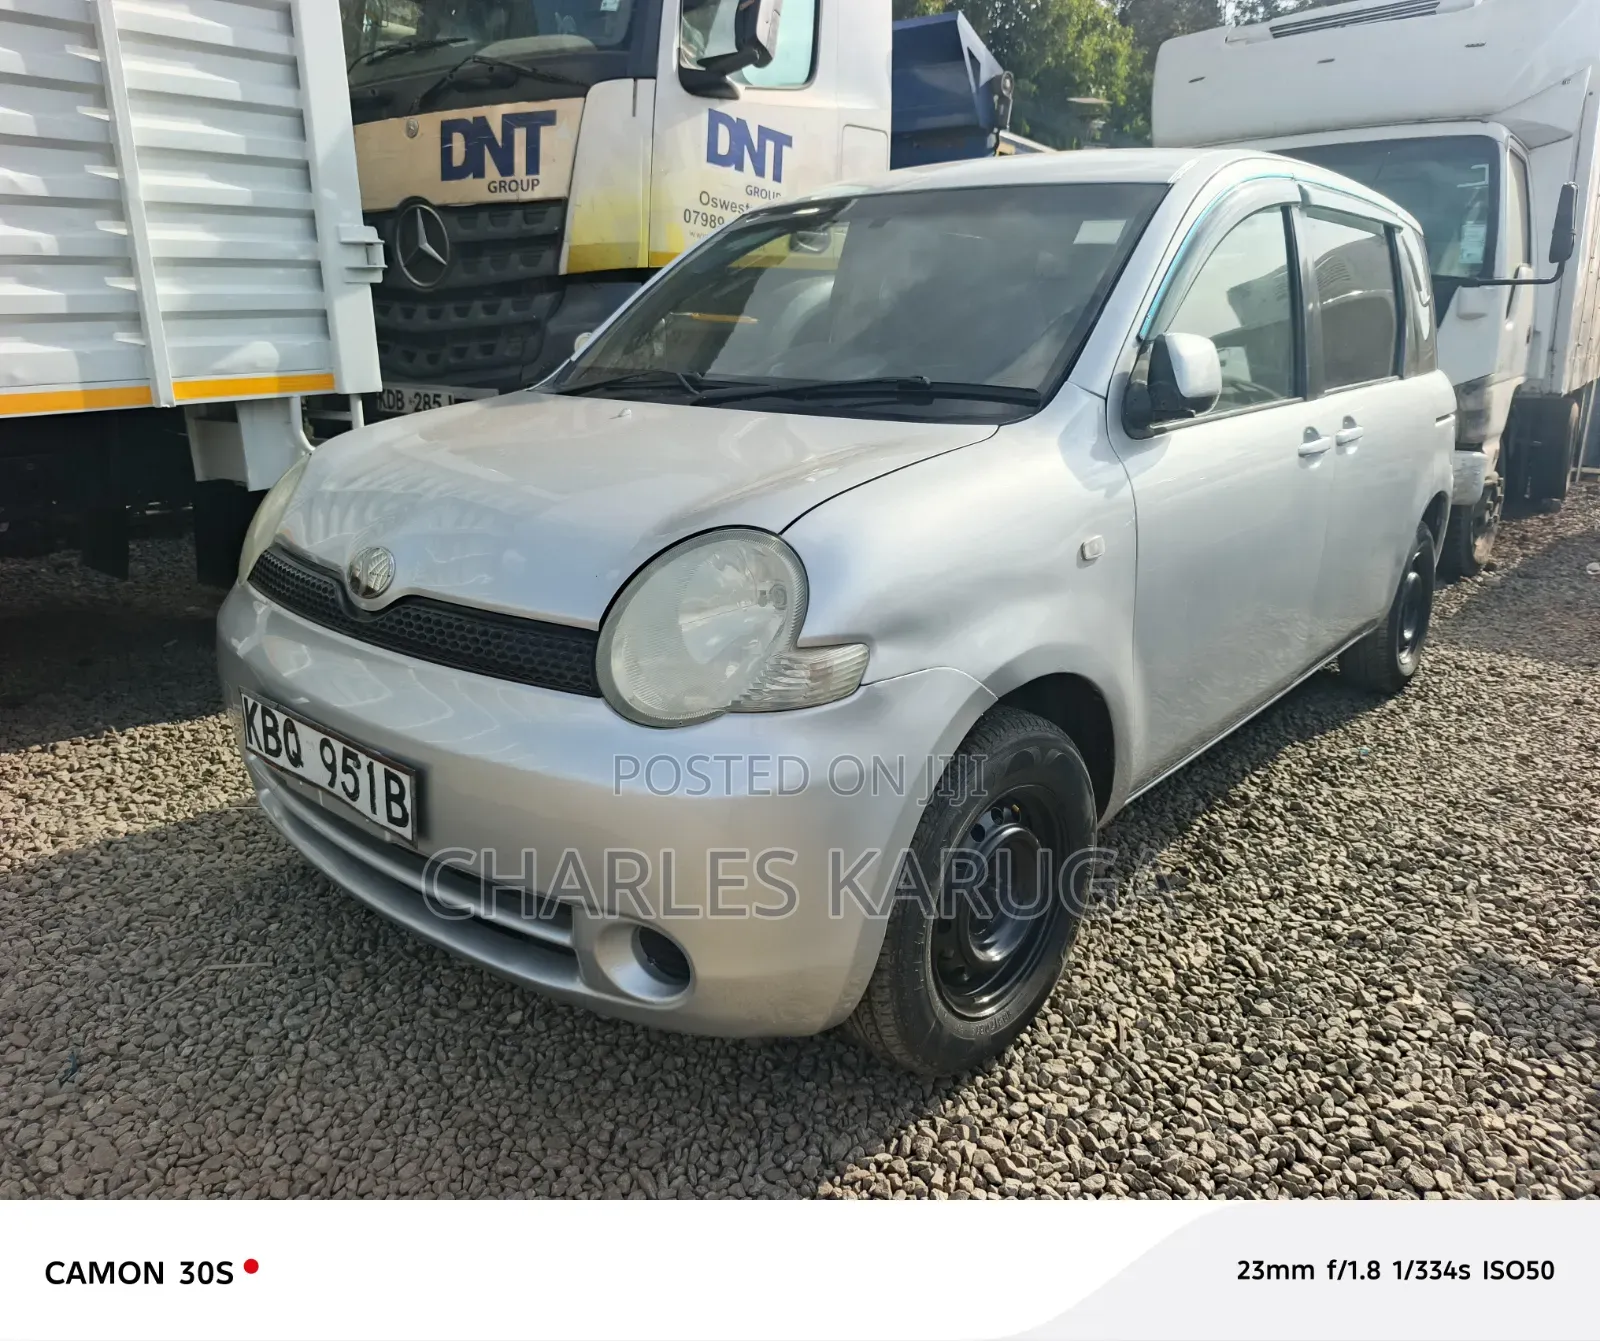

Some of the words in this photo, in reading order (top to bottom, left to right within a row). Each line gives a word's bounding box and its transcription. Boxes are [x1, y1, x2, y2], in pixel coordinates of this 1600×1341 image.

[441, 110, 557, 181] DNT
[707, 108, 793, 184] DNT
[487, 178, 540, 194] GROUP
[699, 190, 753, 215] Oswest
[379, 388, 405, 411] KDB
[243, 696, 304, 769] KBQ
[319, 737, 410, 828] 951B
